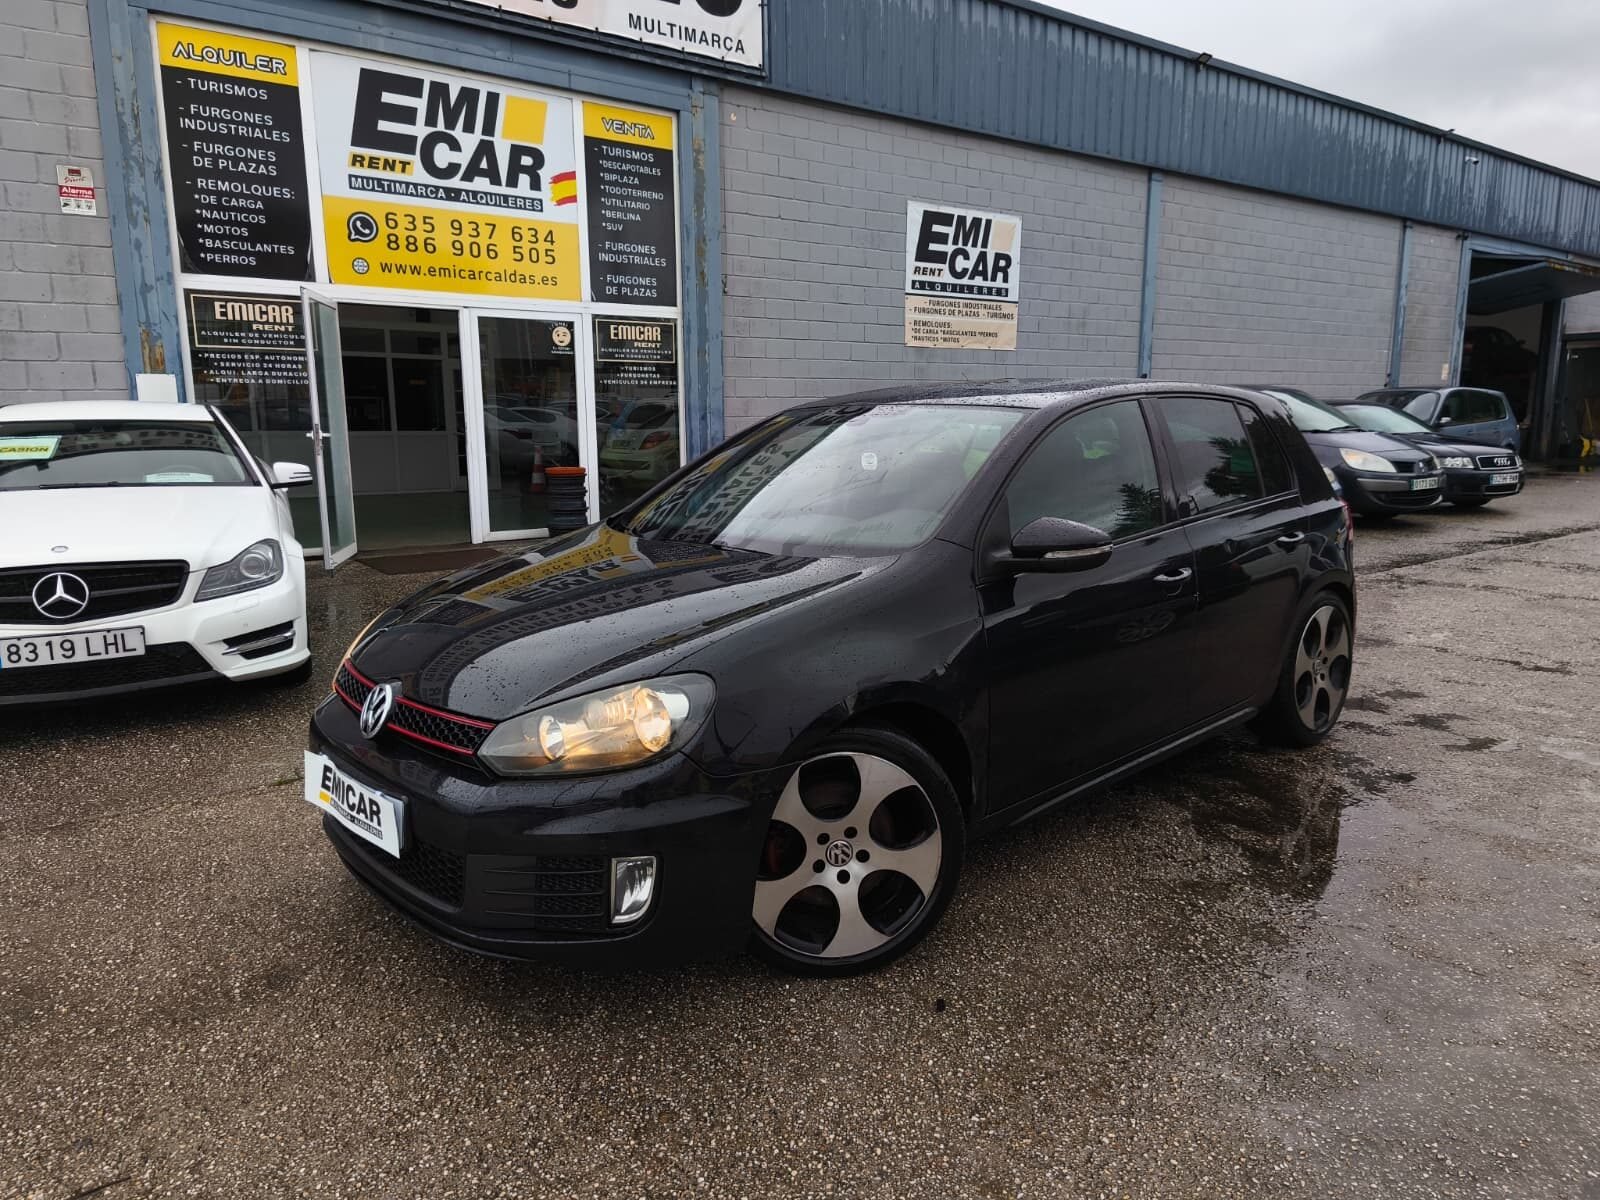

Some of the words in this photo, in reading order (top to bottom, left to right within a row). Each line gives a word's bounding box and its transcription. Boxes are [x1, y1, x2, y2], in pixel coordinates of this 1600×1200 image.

[628, 13, 745, 54] MULTIMARCA
[172, 41, 287, 75] ALQUILER
[187, 78, 268, 100] TURISMOS
[190, 104, 273, 126] FURGONES
[350, 67, 500, 156] EMI
[180, 118, 290, 142] INDUSTRIALES
[601, 116, 655, 140] VENTA
[193, 142, 276, 162] FURGONES
[419, 130, 545, 192] CAR
[602, 145, 654, 162] TURISMOS
[192, 156, 214, 168] DE
[218, 159, 278, 176] PLAZAS
[351, 154, 410, 174] RENT
[197, 178, 296, 200] REMOLQUES:
[350, 176, 446, 200] MULTIMARCA
[460, 193, 542, 211] ALQUILERES
[222, 196, 264, 210] CARGA
[385, 212, 436, 234] 635
[450, 220, 496, 240] 937
[512, 226, 556, 246] 634
[914, 210, 992, 264] EMI
[386, 234, 437, 254] 886
[452, 240, 499, 260] 906
[512, 246, 556, 265] 505
[598, 252, 666, 266] INDUSTRIALES
[606, 242, 656, 254] FURGONES
[380, 260, 558, 286] www.emicarcaldas.es
[914, 266, 944, 277] RENT
[948, 247, 1012, 284] CAR
[606, 274, 657, 286] FURGONES
[914, 281, 1006, 296] ALQUILERES
[606, 286, 618, 294] DE
[622, 287, 657, 298] PLAZAS
[214, 301, 294, 324] EMICAR
[914, 306, 946, 316] FURGONES
[958, 309, 980, 318] PLAZAS
[986, 312, 1014, 320] TURISMOS
[928, 300, 960, 309] FURGONES
[962, 302, 1002, 311] INDUSTRIALES
[252, 324, 295, 332] RENT
[610, 324, 661, 341] EMICAR
[913, 320, 953, 329] REMOLQUES:
[6, 638, 76, 664] 8319
[85, 633, 136, 656] LHL
[320, 764, 382, 828] EMICAR
